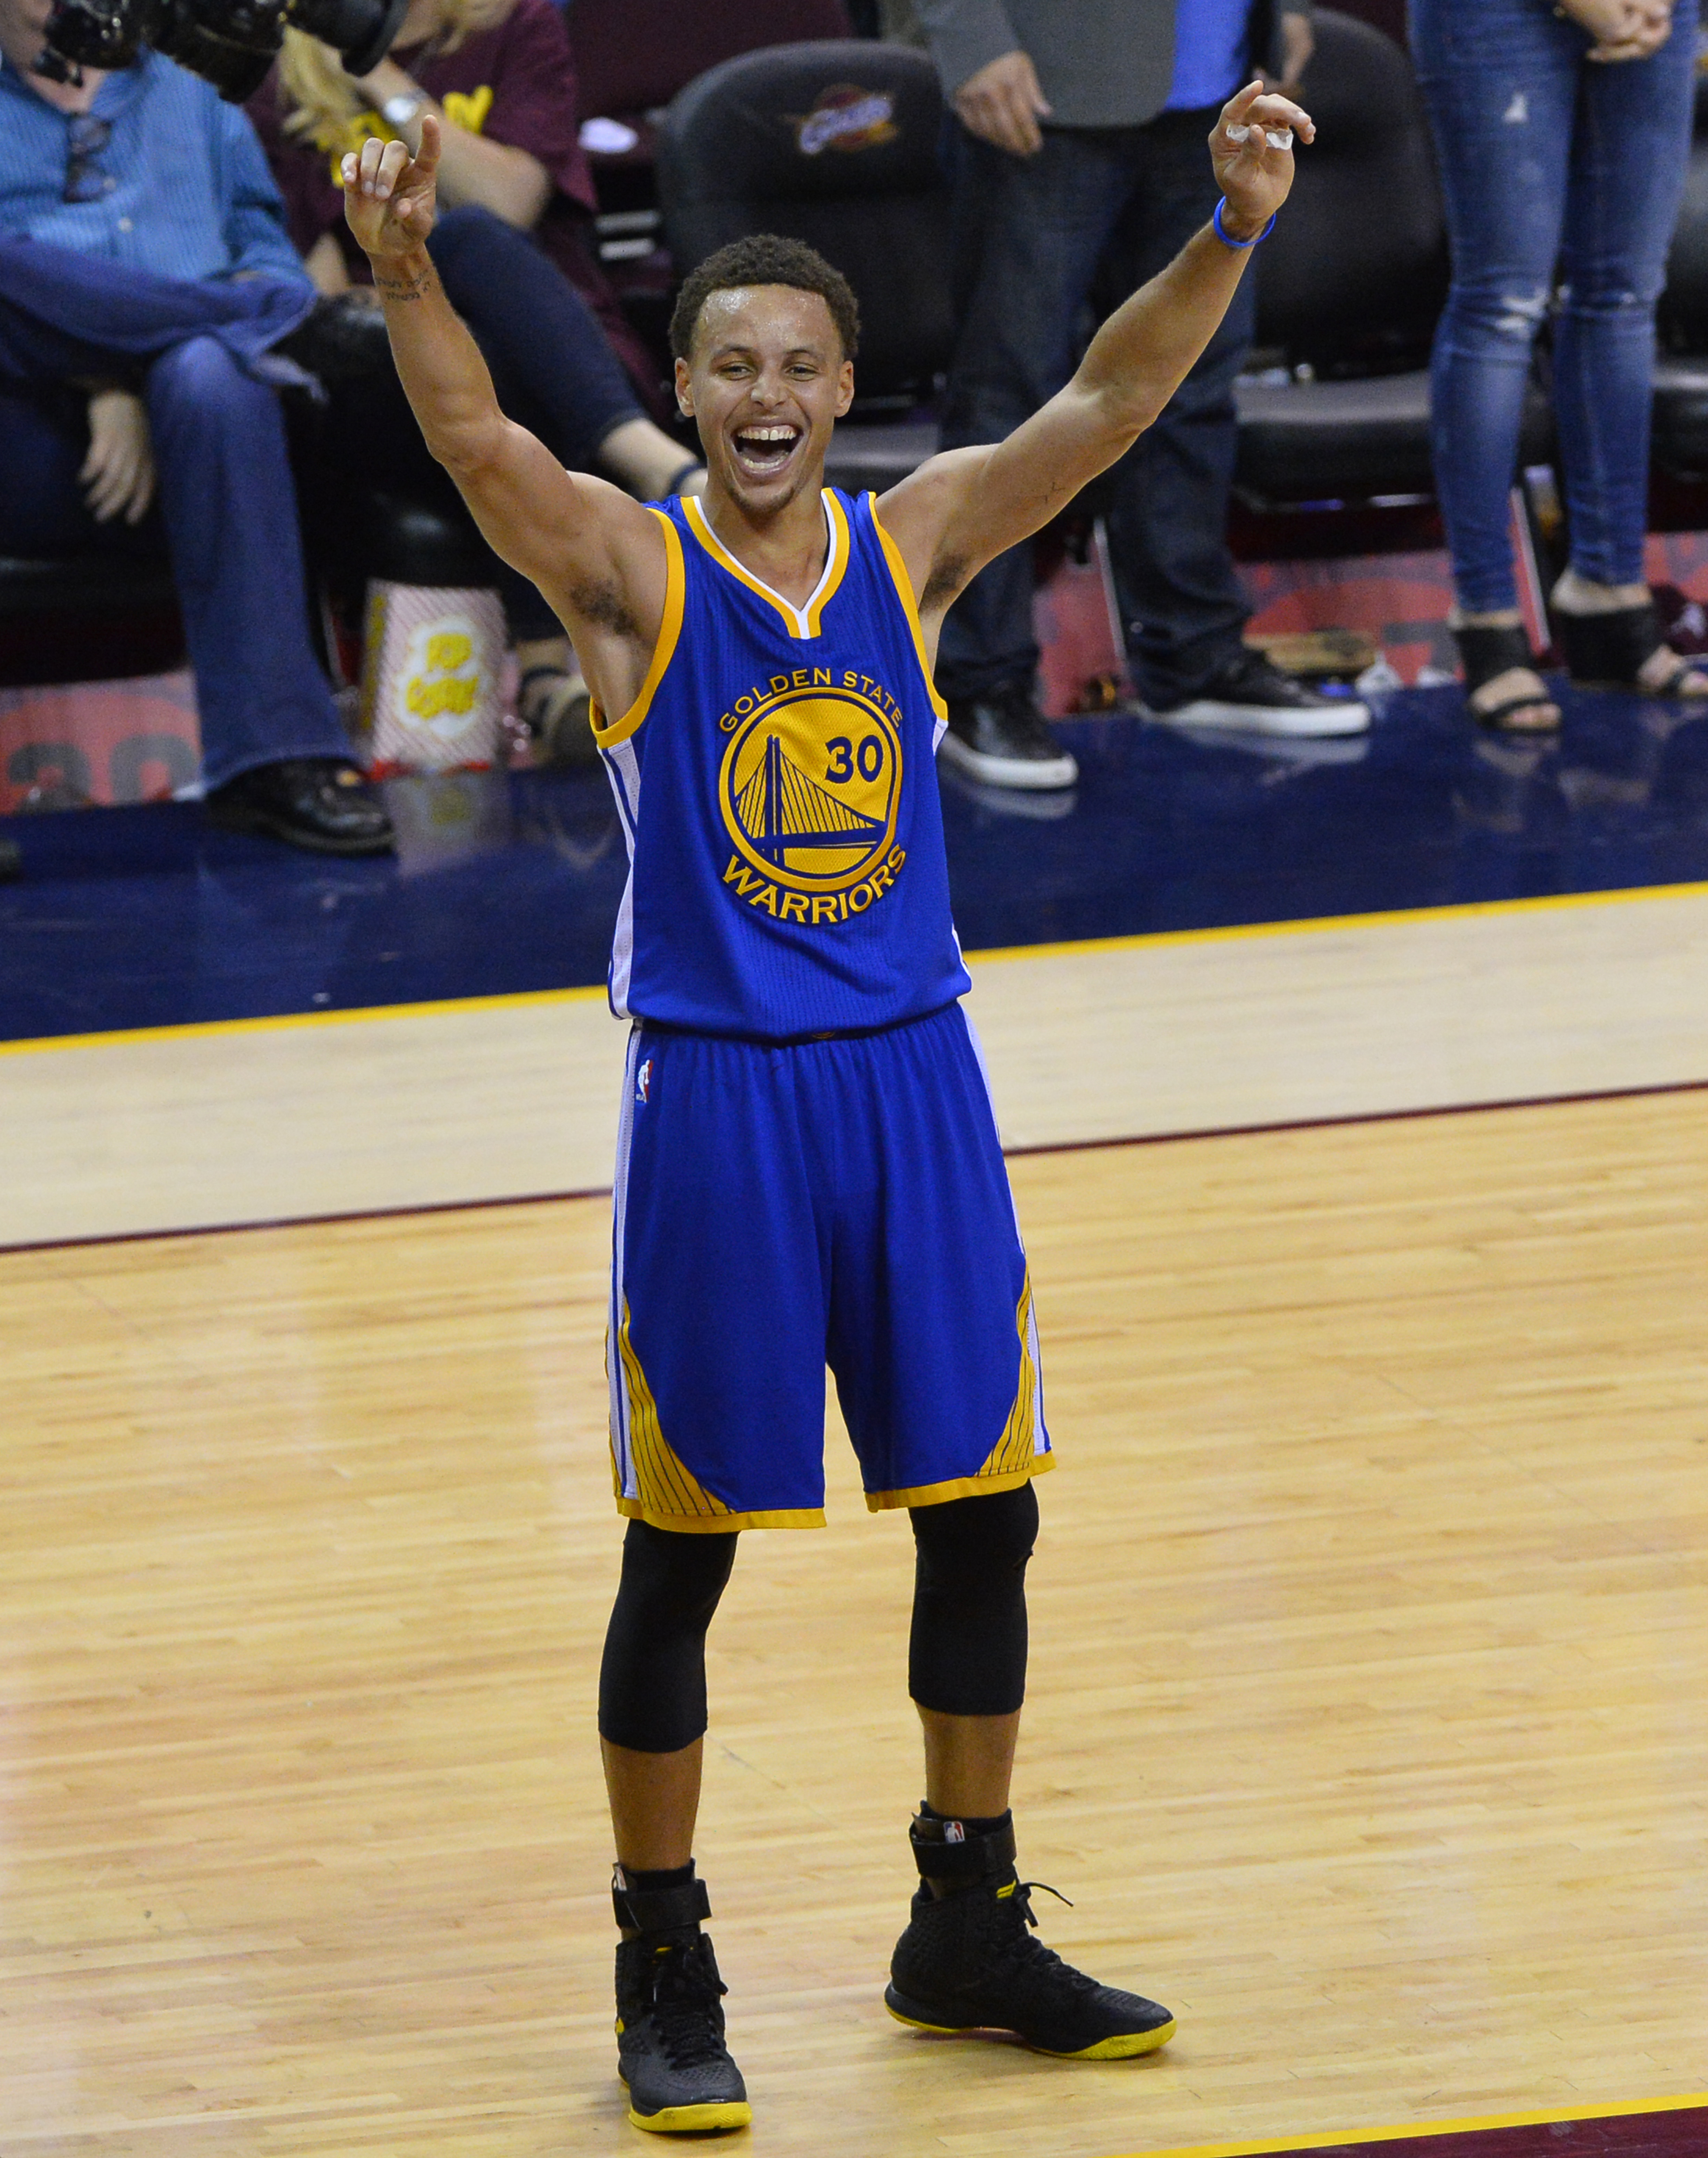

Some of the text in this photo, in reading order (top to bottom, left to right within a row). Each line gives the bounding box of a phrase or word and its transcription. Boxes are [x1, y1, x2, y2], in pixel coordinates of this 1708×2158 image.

[720, 668, 903, 733] GOLDEN STATE
[825, 734, 884, 784] 30
[722, 844, 907, 924] WARRIORS
